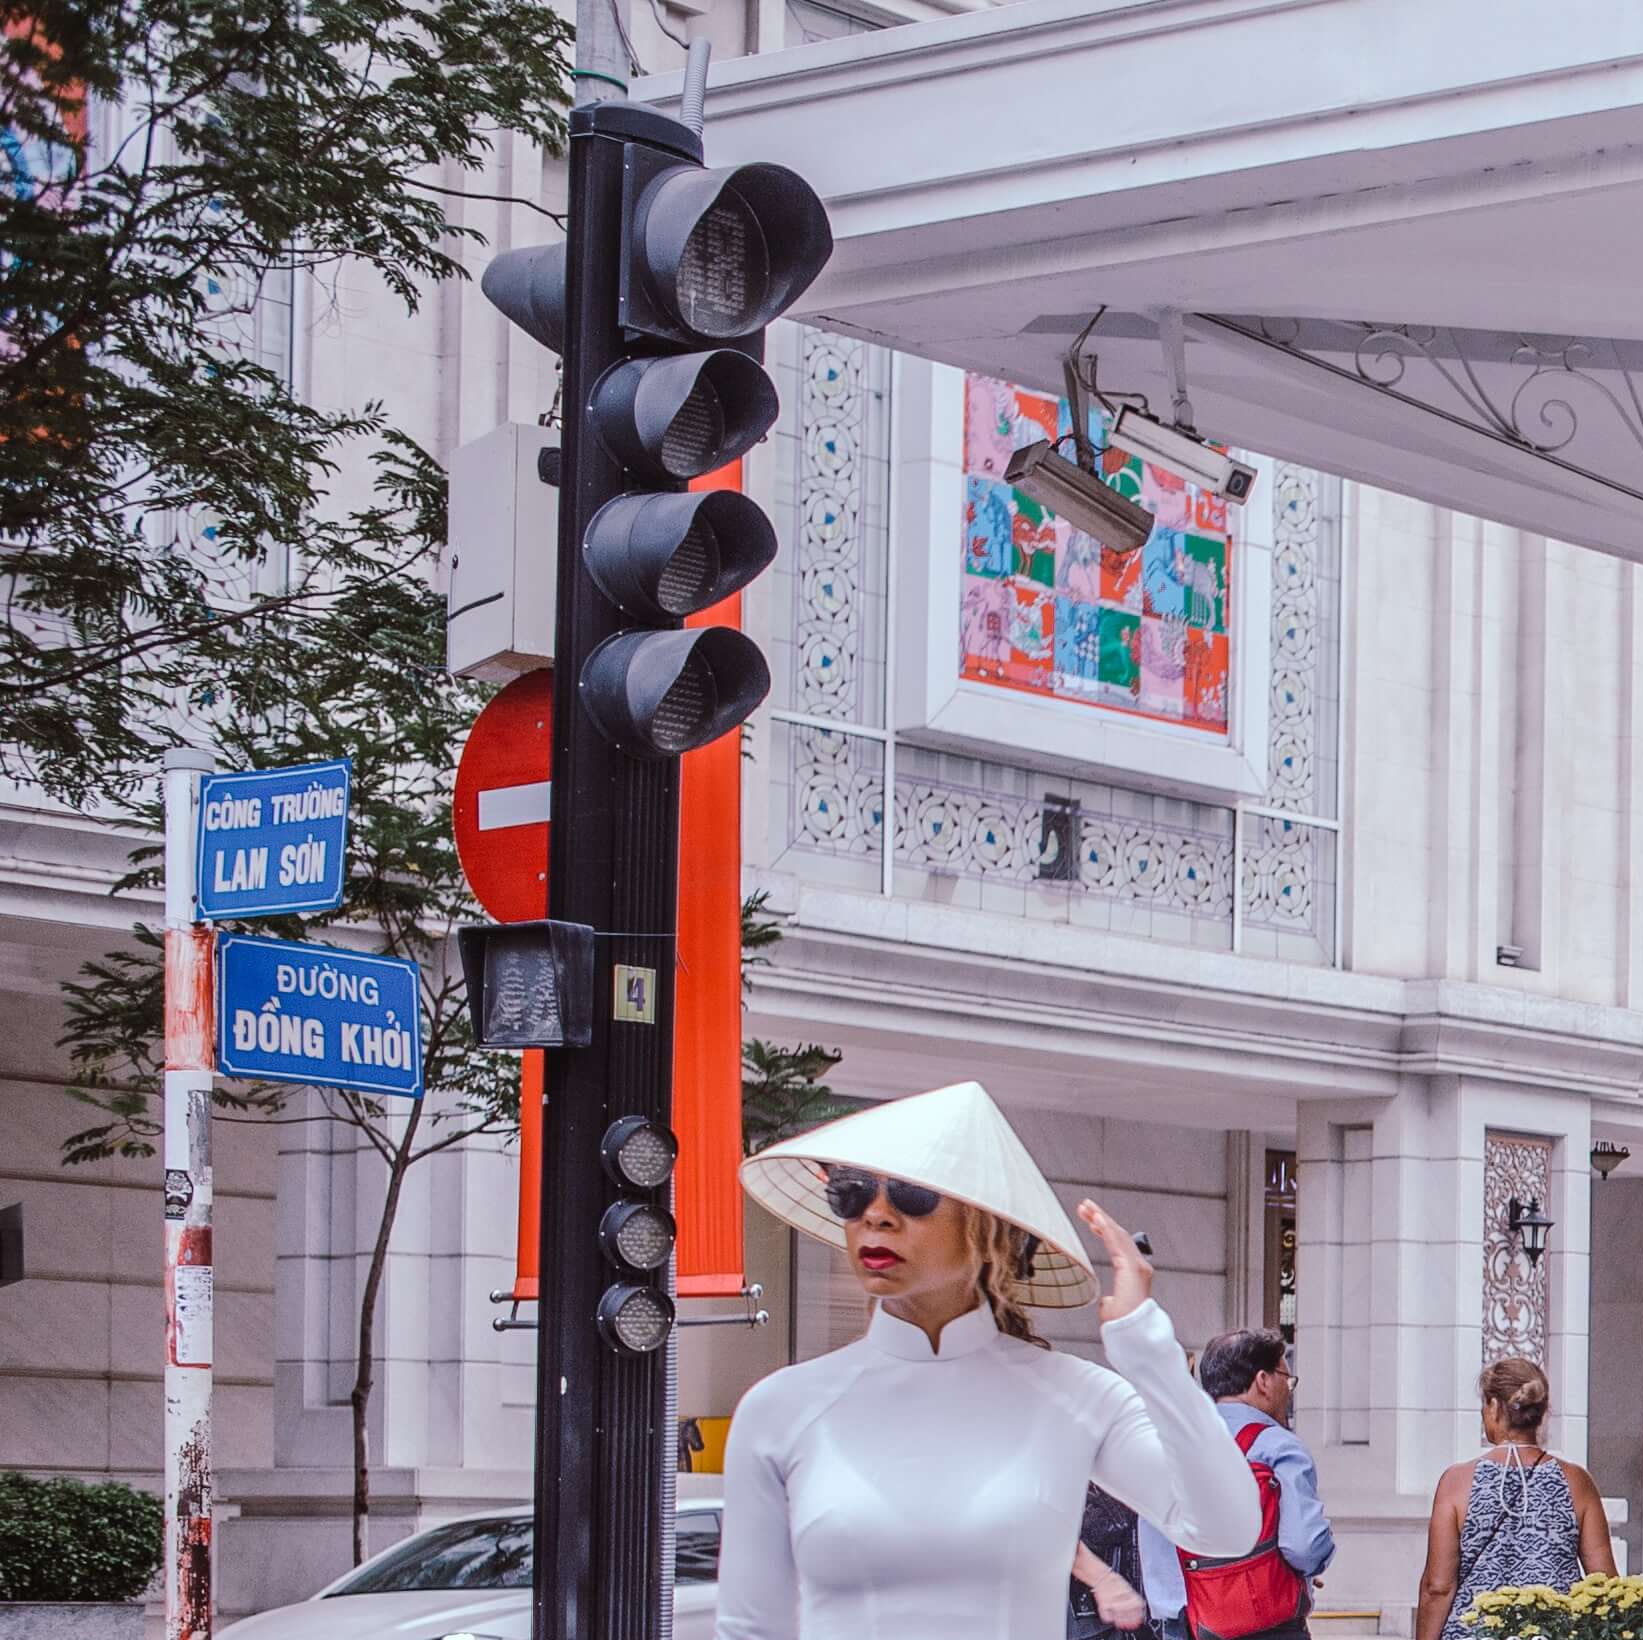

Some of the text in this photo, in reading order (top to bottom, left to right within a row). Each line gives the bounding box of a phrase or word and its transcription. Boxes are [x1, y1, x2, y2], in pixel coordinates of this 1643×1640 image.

[206, 781, 345, 831] CÔNG TRƯỜNG
[214, 833, 326, 893] LAM SƠN
[276, 963, 380, 1006] ĐƯỜNG
[233, 995, 412, 1071] ĐỒNG KHỞI
